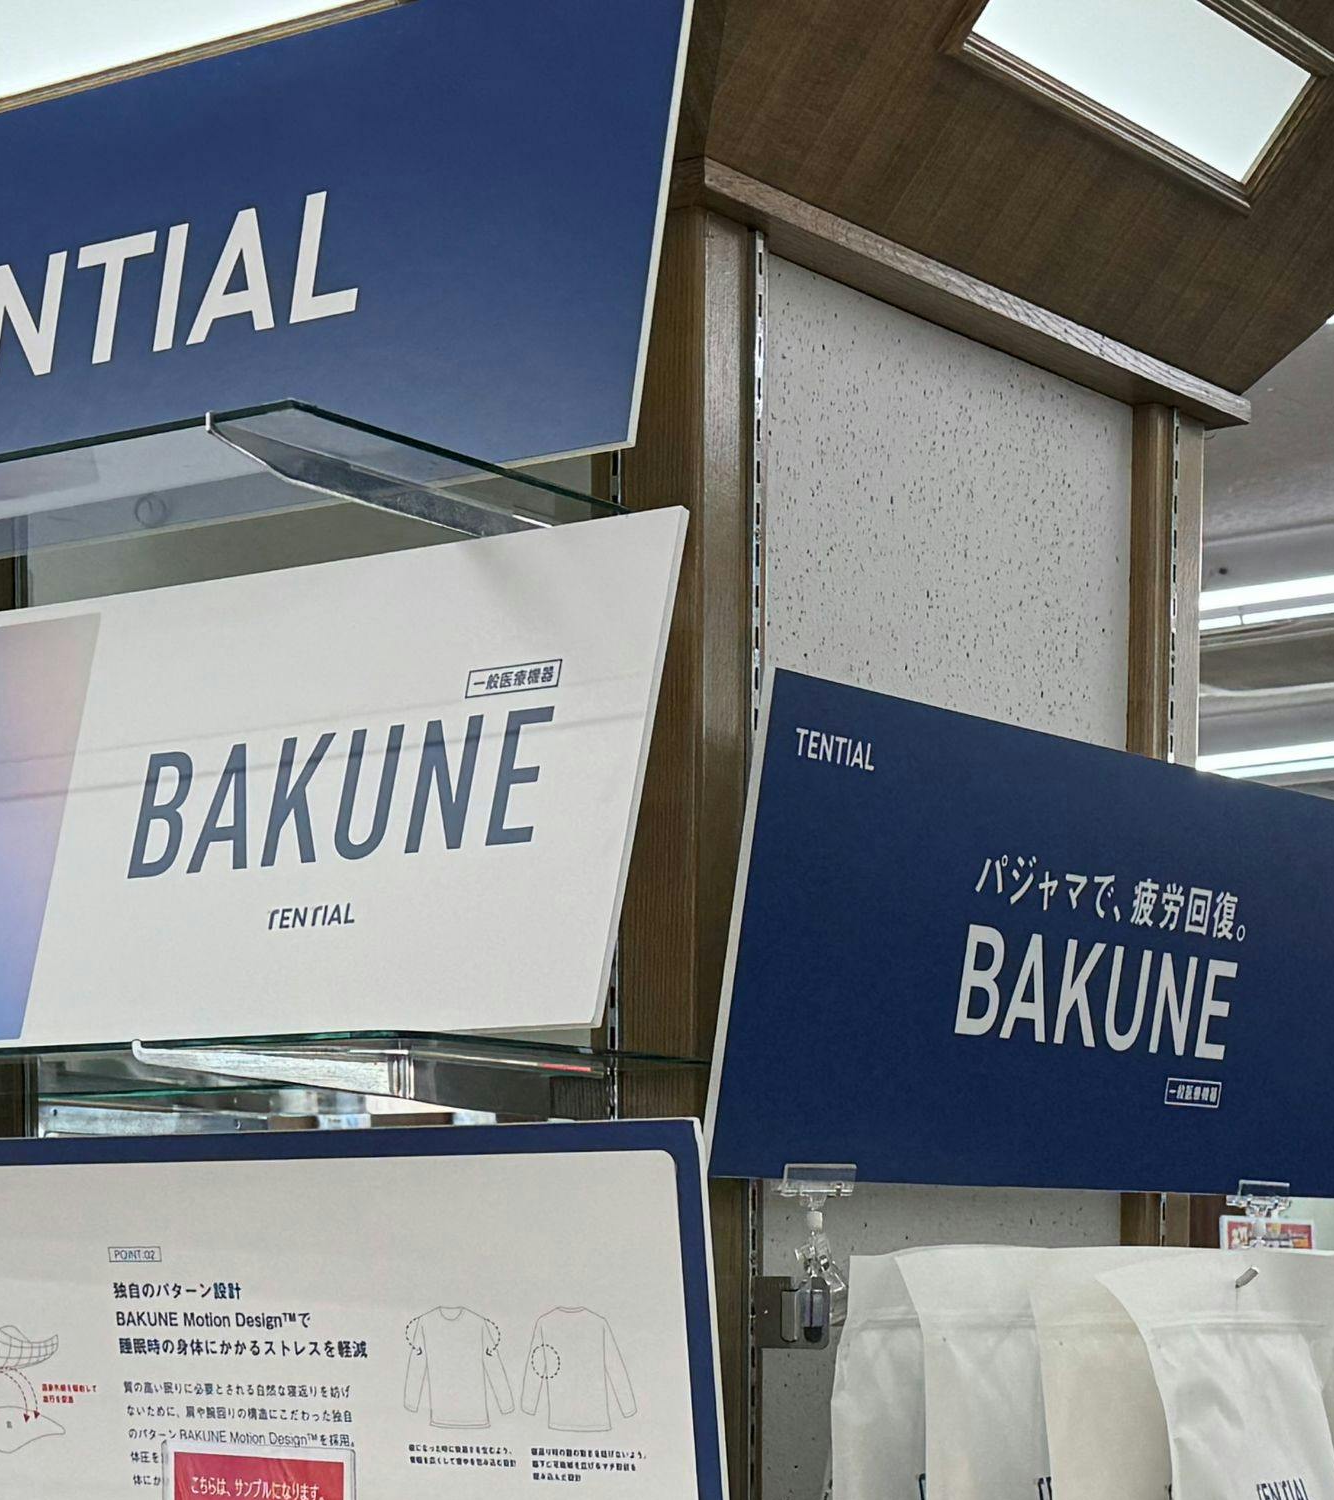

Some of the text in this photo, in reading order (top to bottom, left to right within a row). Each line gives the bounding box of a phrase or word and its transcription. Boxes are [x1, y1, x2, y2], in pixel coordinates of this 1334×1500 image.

[796, 728, 875, 771] TENTIAL
[127, 706, 555, 881] BAKUNE
[974, 853, 1247, 942] パジャマで、疲労回復。
[267, 902, 355, 931] TENTIAL
[954, 924, 1239, 1061] BAKUNE
[113, 1282, 242, 1301] 独自のパターン設計
[116, 1311, 179, 1327] BAKUNE
[183, 1311, 231, 1328] Motion
[119, 1337, 369, 1359] 睡眠時の身体にかかるストレスを軽減
